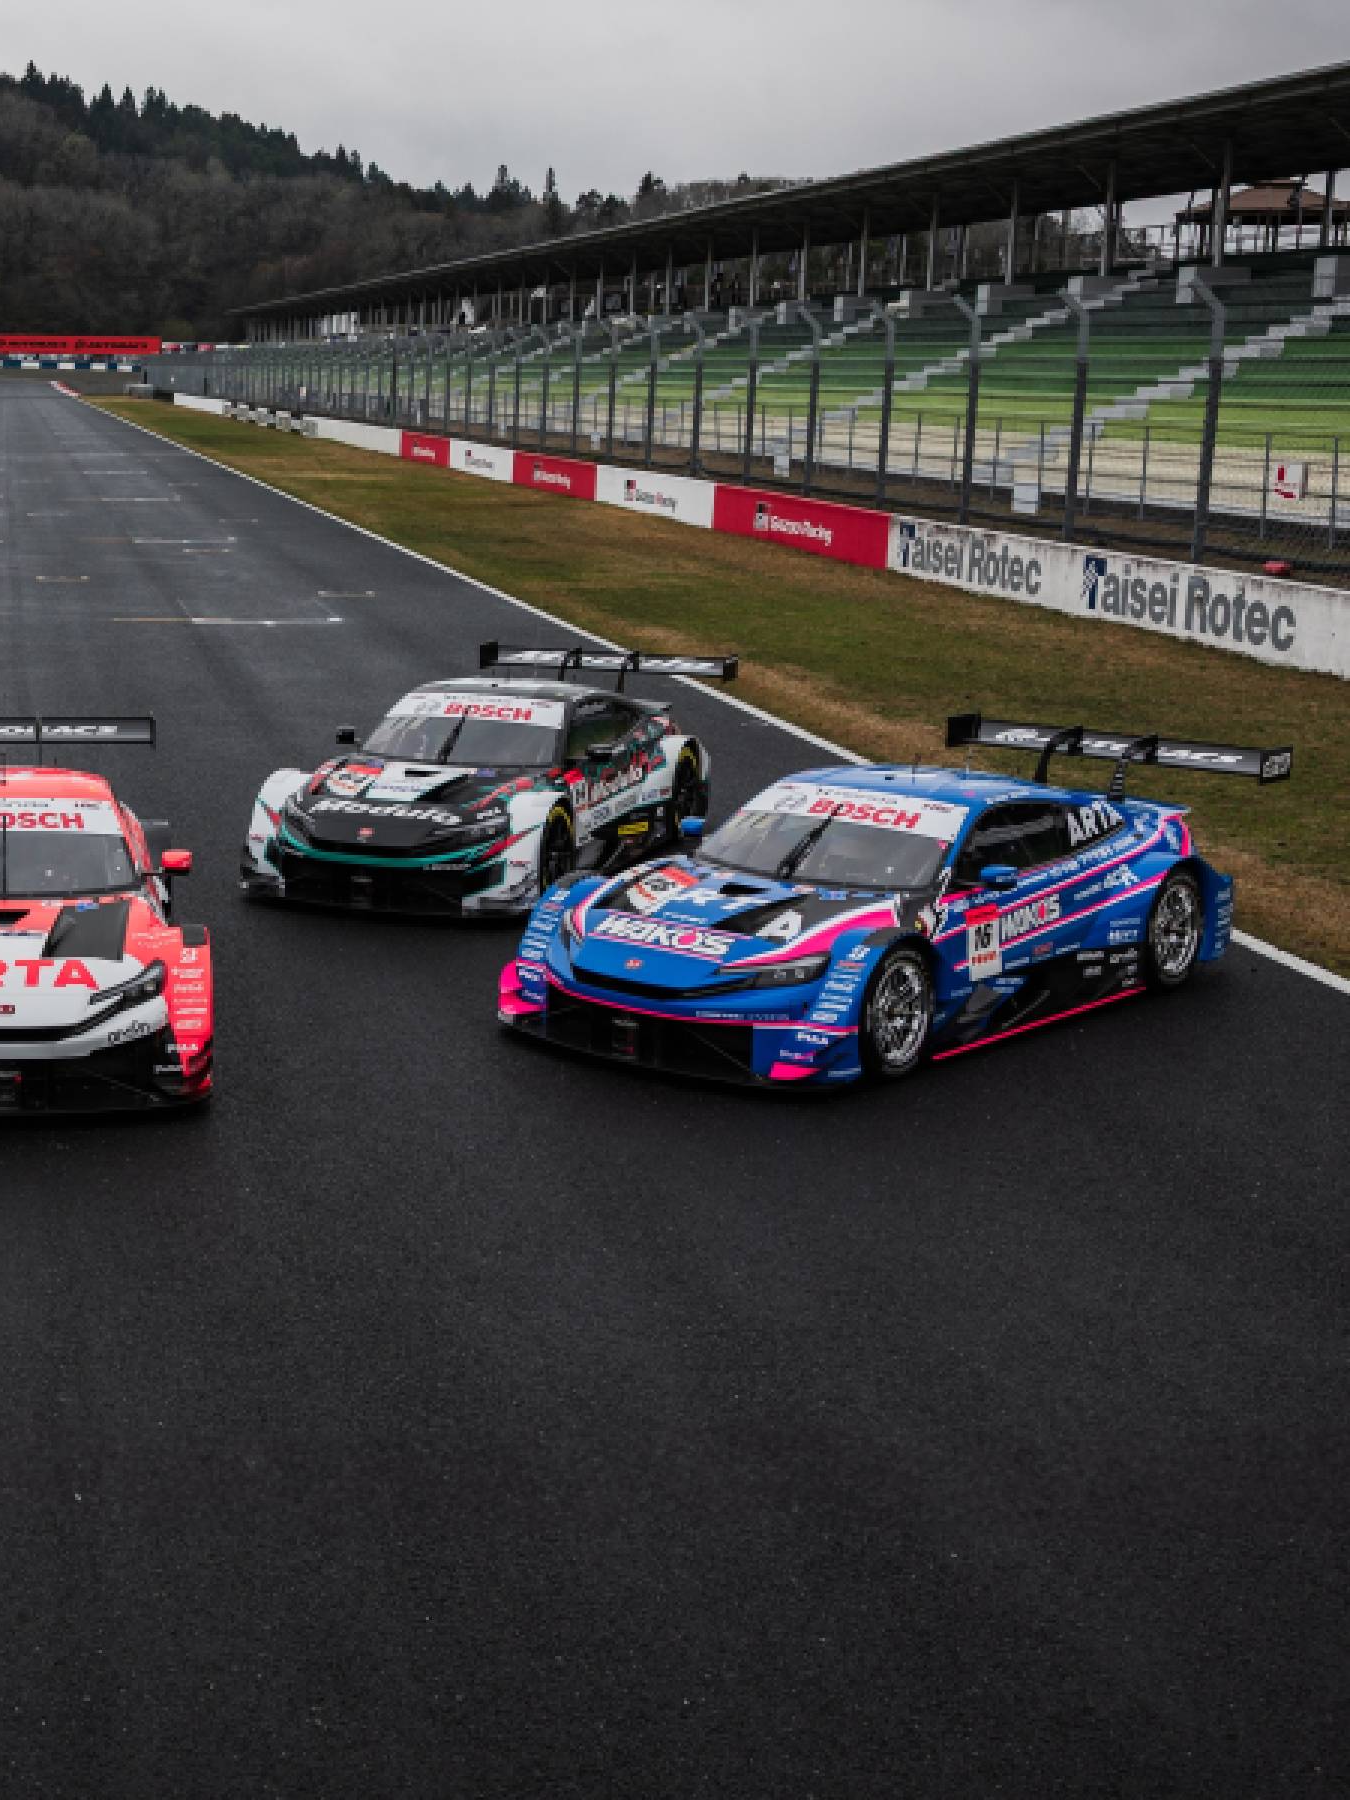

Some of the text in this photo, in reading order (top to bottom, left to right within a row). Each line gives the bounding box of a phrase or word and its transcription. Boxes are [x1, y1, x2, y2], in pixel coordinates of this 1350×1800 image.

[967, 536, 1042, 597] Rotec
[1184, 576, 1297, 652] Rotec
[443, 702, 534, 721] BOSCH
[311, 799, 463, 826] Modulo
[809, 798, 923, 829] BOSCH
[1067, 799, 1126, 847] ARTA
[973, 923, 992, 953] 16
